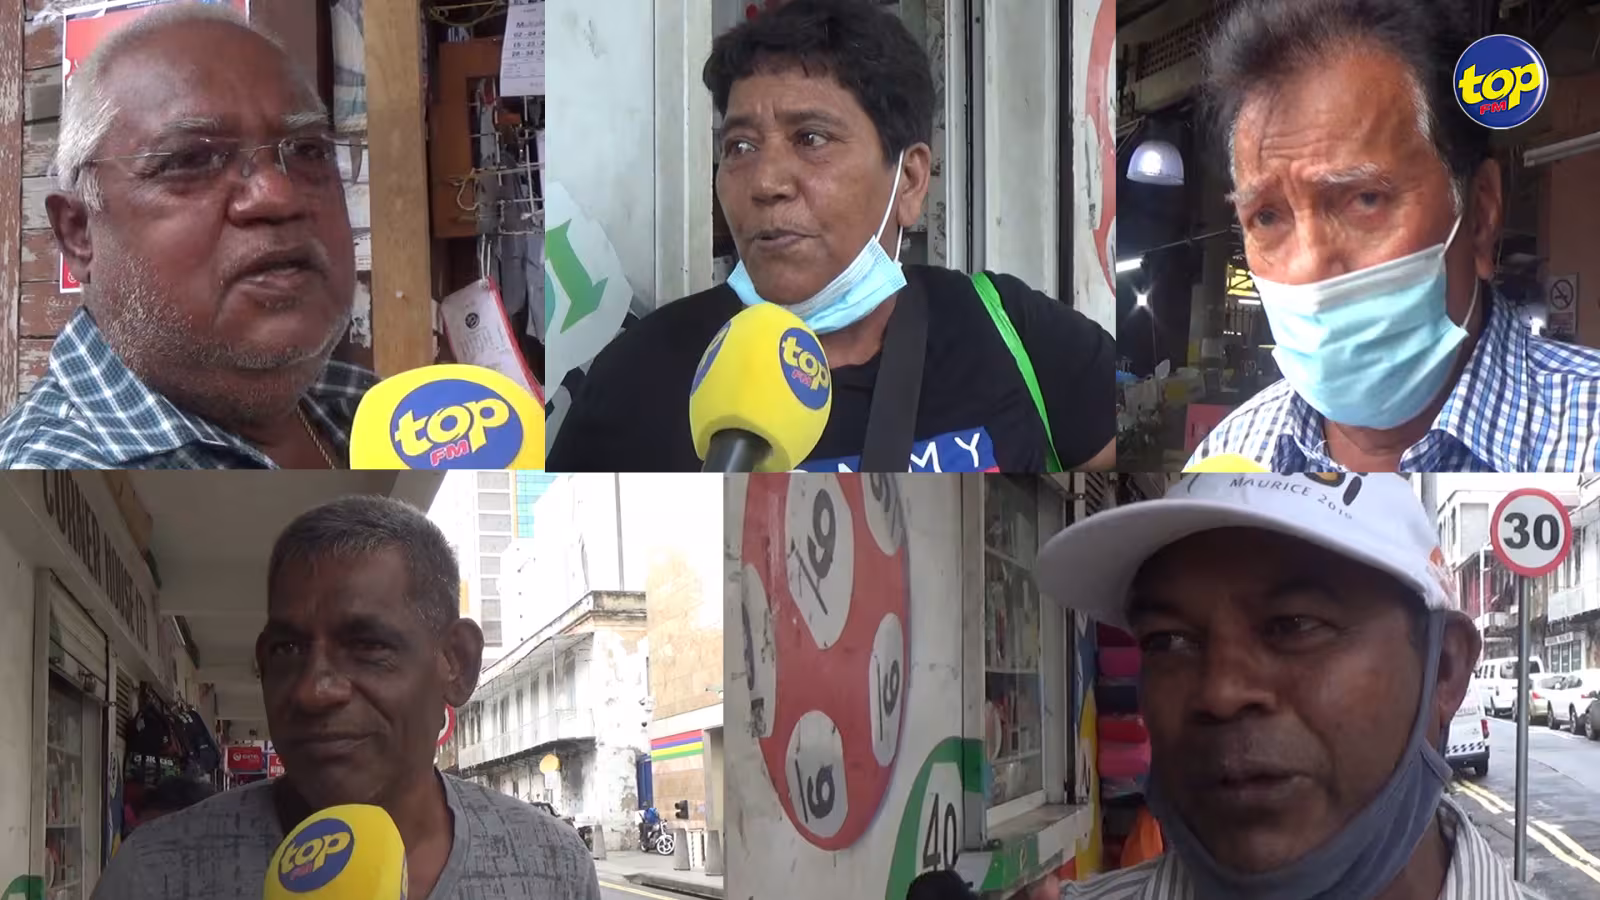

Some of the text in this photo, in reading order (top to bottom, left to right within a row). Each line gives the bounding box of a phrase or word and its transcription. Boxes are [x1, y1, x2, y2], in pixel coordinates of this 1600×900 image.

[782, 336, 830, 391] top
[395, 398, 509, 457] top
[430, 440, 469, 467] FM
[1229, 476, 1314, 497] MAURICE
[1503, 512, 1560, 550] 30
[281, 831, 351, 874] top
[922, 793, 958, 872] 40
